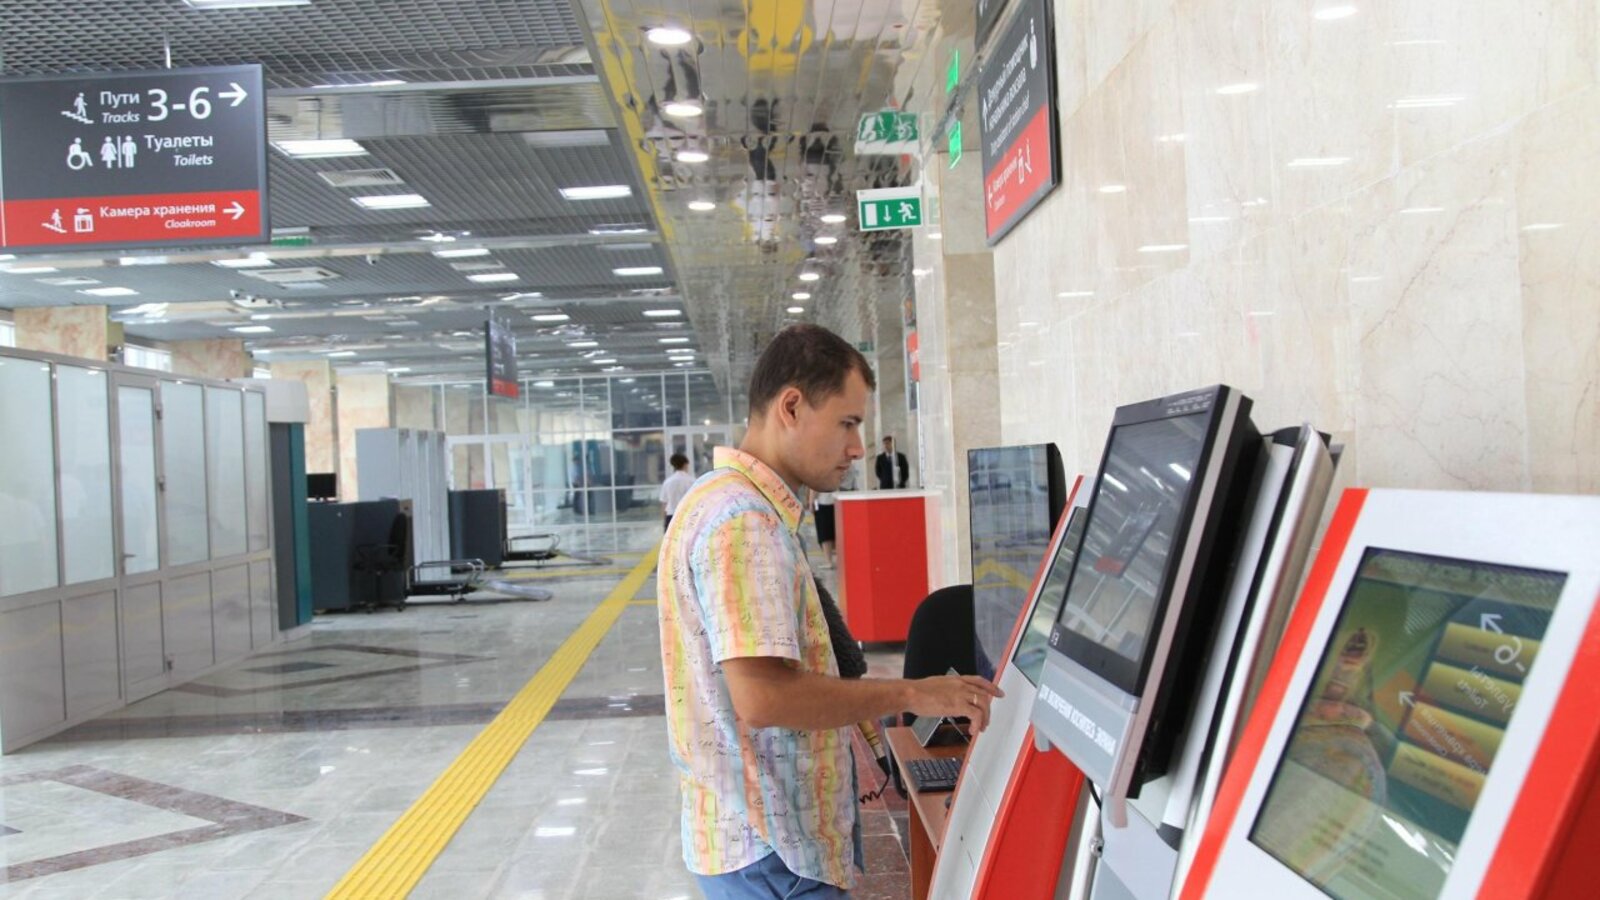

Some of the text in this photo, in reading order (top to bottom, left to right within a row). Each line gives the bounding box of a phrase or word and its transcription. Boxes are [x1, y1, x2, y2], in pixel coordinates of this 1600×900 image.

[100, 86, 212, 121] Пути 3-6
[102, 111, 140, 123] Tracks
[144, 134, 213, 152] Туалеты
[173, 153, 213, 166] Toilets
[99, 203, 216, 219] Камера хранения
[164, 218, 216, 230] Cloakroom
